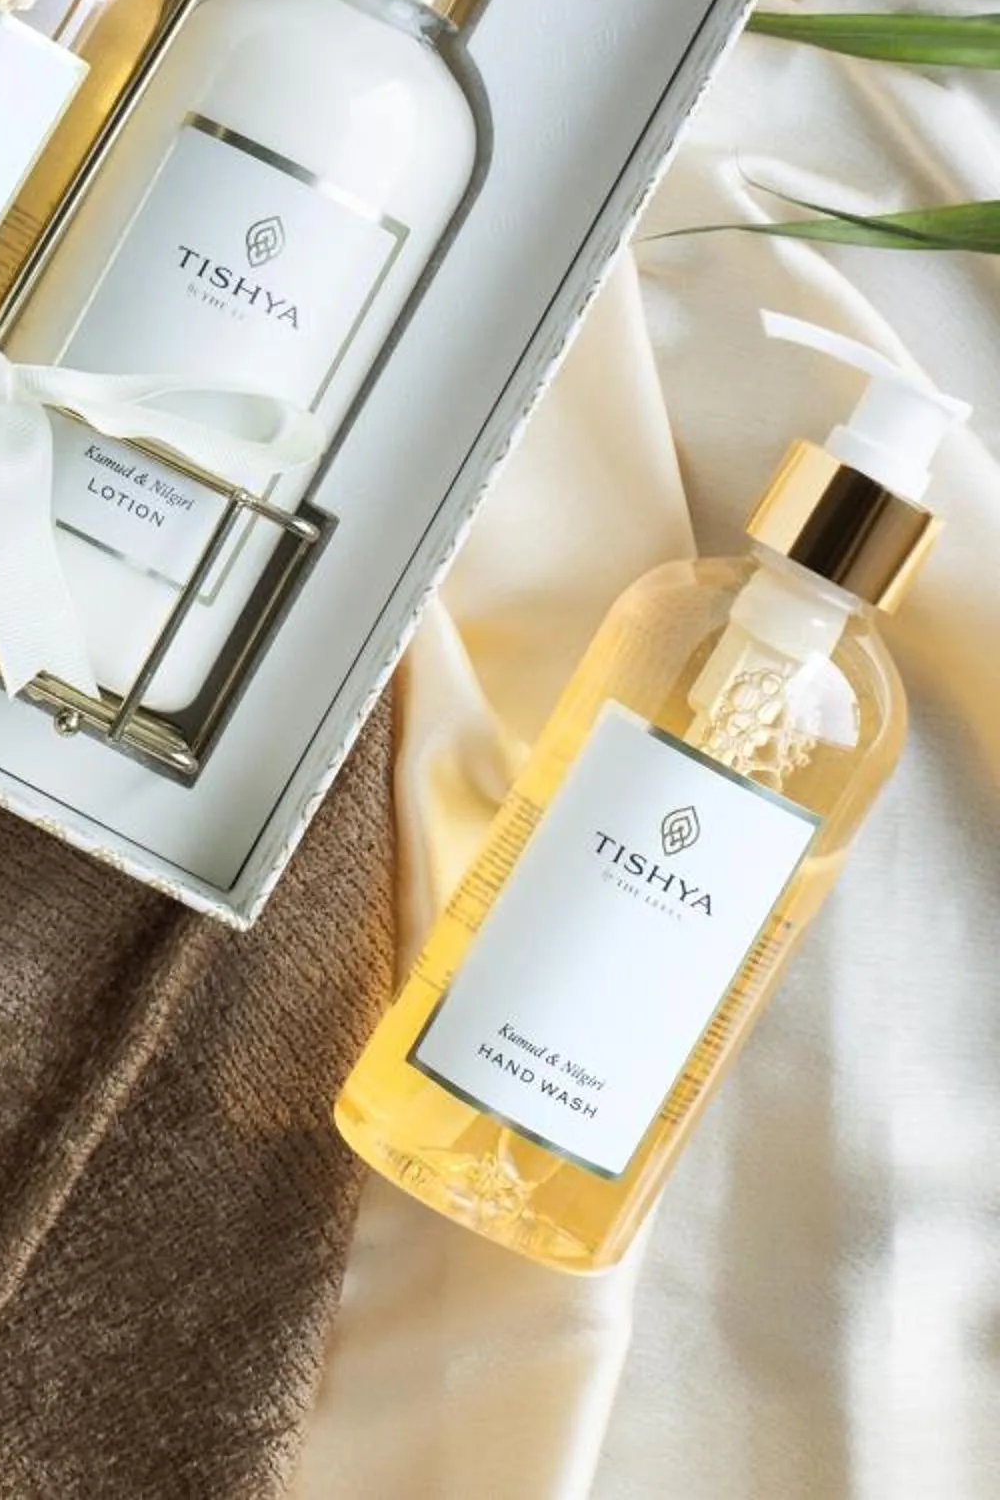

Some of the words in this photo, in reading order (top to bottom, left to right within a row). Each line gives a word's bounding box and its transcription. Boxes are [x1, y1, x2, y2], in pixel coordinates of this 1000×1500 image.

[178, 245, 299, 330] TISHYA
[84, 445, 137, 479] Kumud
[133, 473, 150, 486] &
[148, 480, 196, 511] Nilgiri
[87, 477, 165, 528] LOTION
[596, 831, 711, 916] TISHYA
[498, 1022, 549, 1058] Kumud
[545, 1053, 561, 1067] &
[478, 1043, 535, 1083] HAND
[540, 1079, 598, 1119] WASH
